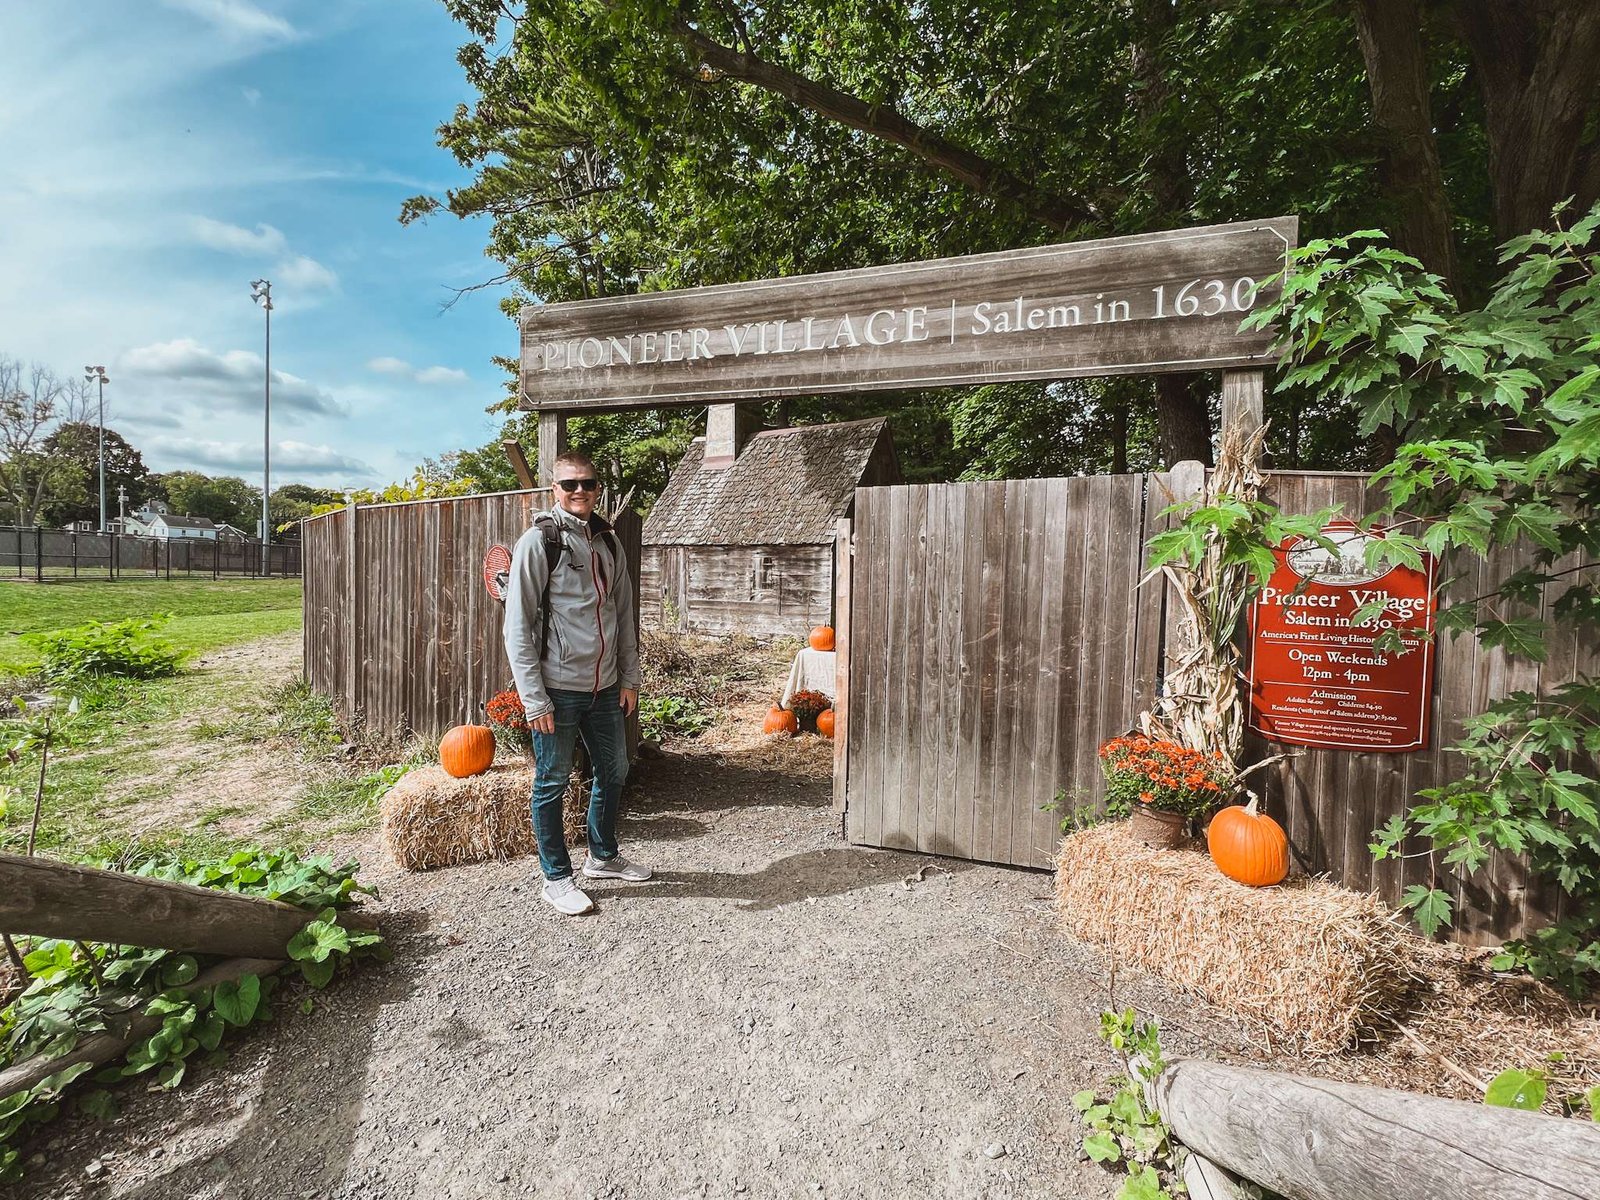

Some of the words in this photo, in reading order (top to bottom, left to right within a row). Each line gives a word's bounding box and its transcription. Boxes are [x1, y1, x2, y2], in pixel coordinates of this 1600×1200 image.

[539, 327, 715, 373] PIONEER
[723, 305, 930, 357] VILLAGE
[971, 296, 1081, 335] Salem
[1093, 293, 1132, 323] in
[1151, 276, 1257, 319] 1630
[1259, 587, 1341, 608] Pioneer
[1285, 610, 1332, 627] Salem
[1334, 614, 1350, 627] in
[1354, 616, 1393, 632] 630
[1260, 630, 1299, 640] America's
[1300, 632, 1319, 641] First
[1320, 633, 1348, 645] Living
[1349, 635, 1375, 644] Histor
[1288, 649, 1322, 664] Open
[1326, 651, 1388, 666] Weekends
[1303, 666, 1332, 680] 12pm
[1343, 669, 1370, 684] 4pm
[1310, 690, 1357, 701] Admission
[1271, 704, 1298, 713] Residents
[1313, 708, 1329, 716] proof
